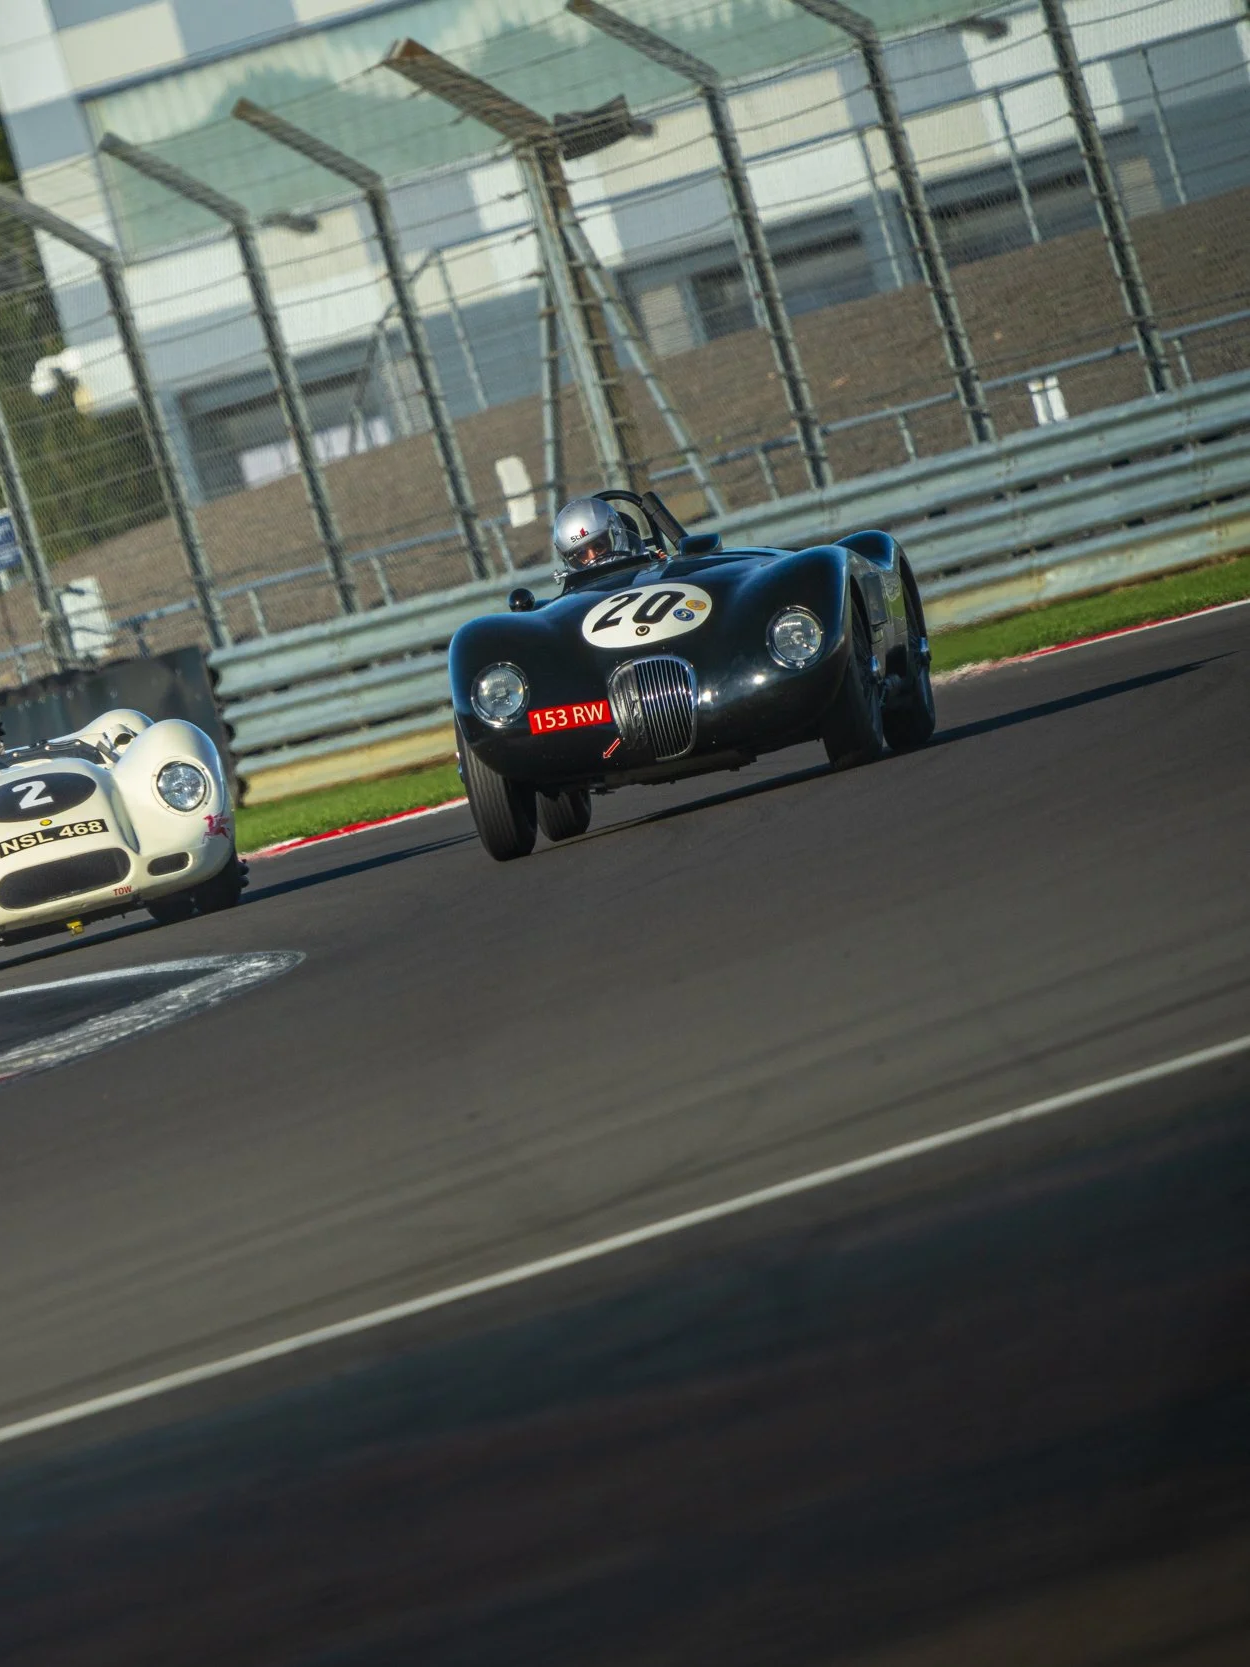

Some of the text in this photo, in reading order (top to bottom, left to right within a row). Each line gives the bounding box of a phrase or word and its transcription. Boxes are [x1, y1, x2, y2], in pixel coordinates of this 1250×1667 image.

[591, 590, 686, 633] 20
[533, 703, 603, 731] 153 RW
[11, 780, 54, 810] 2
[0, 820, 103, 855] NSL 468
[113, 885, 132, 896] TOW
